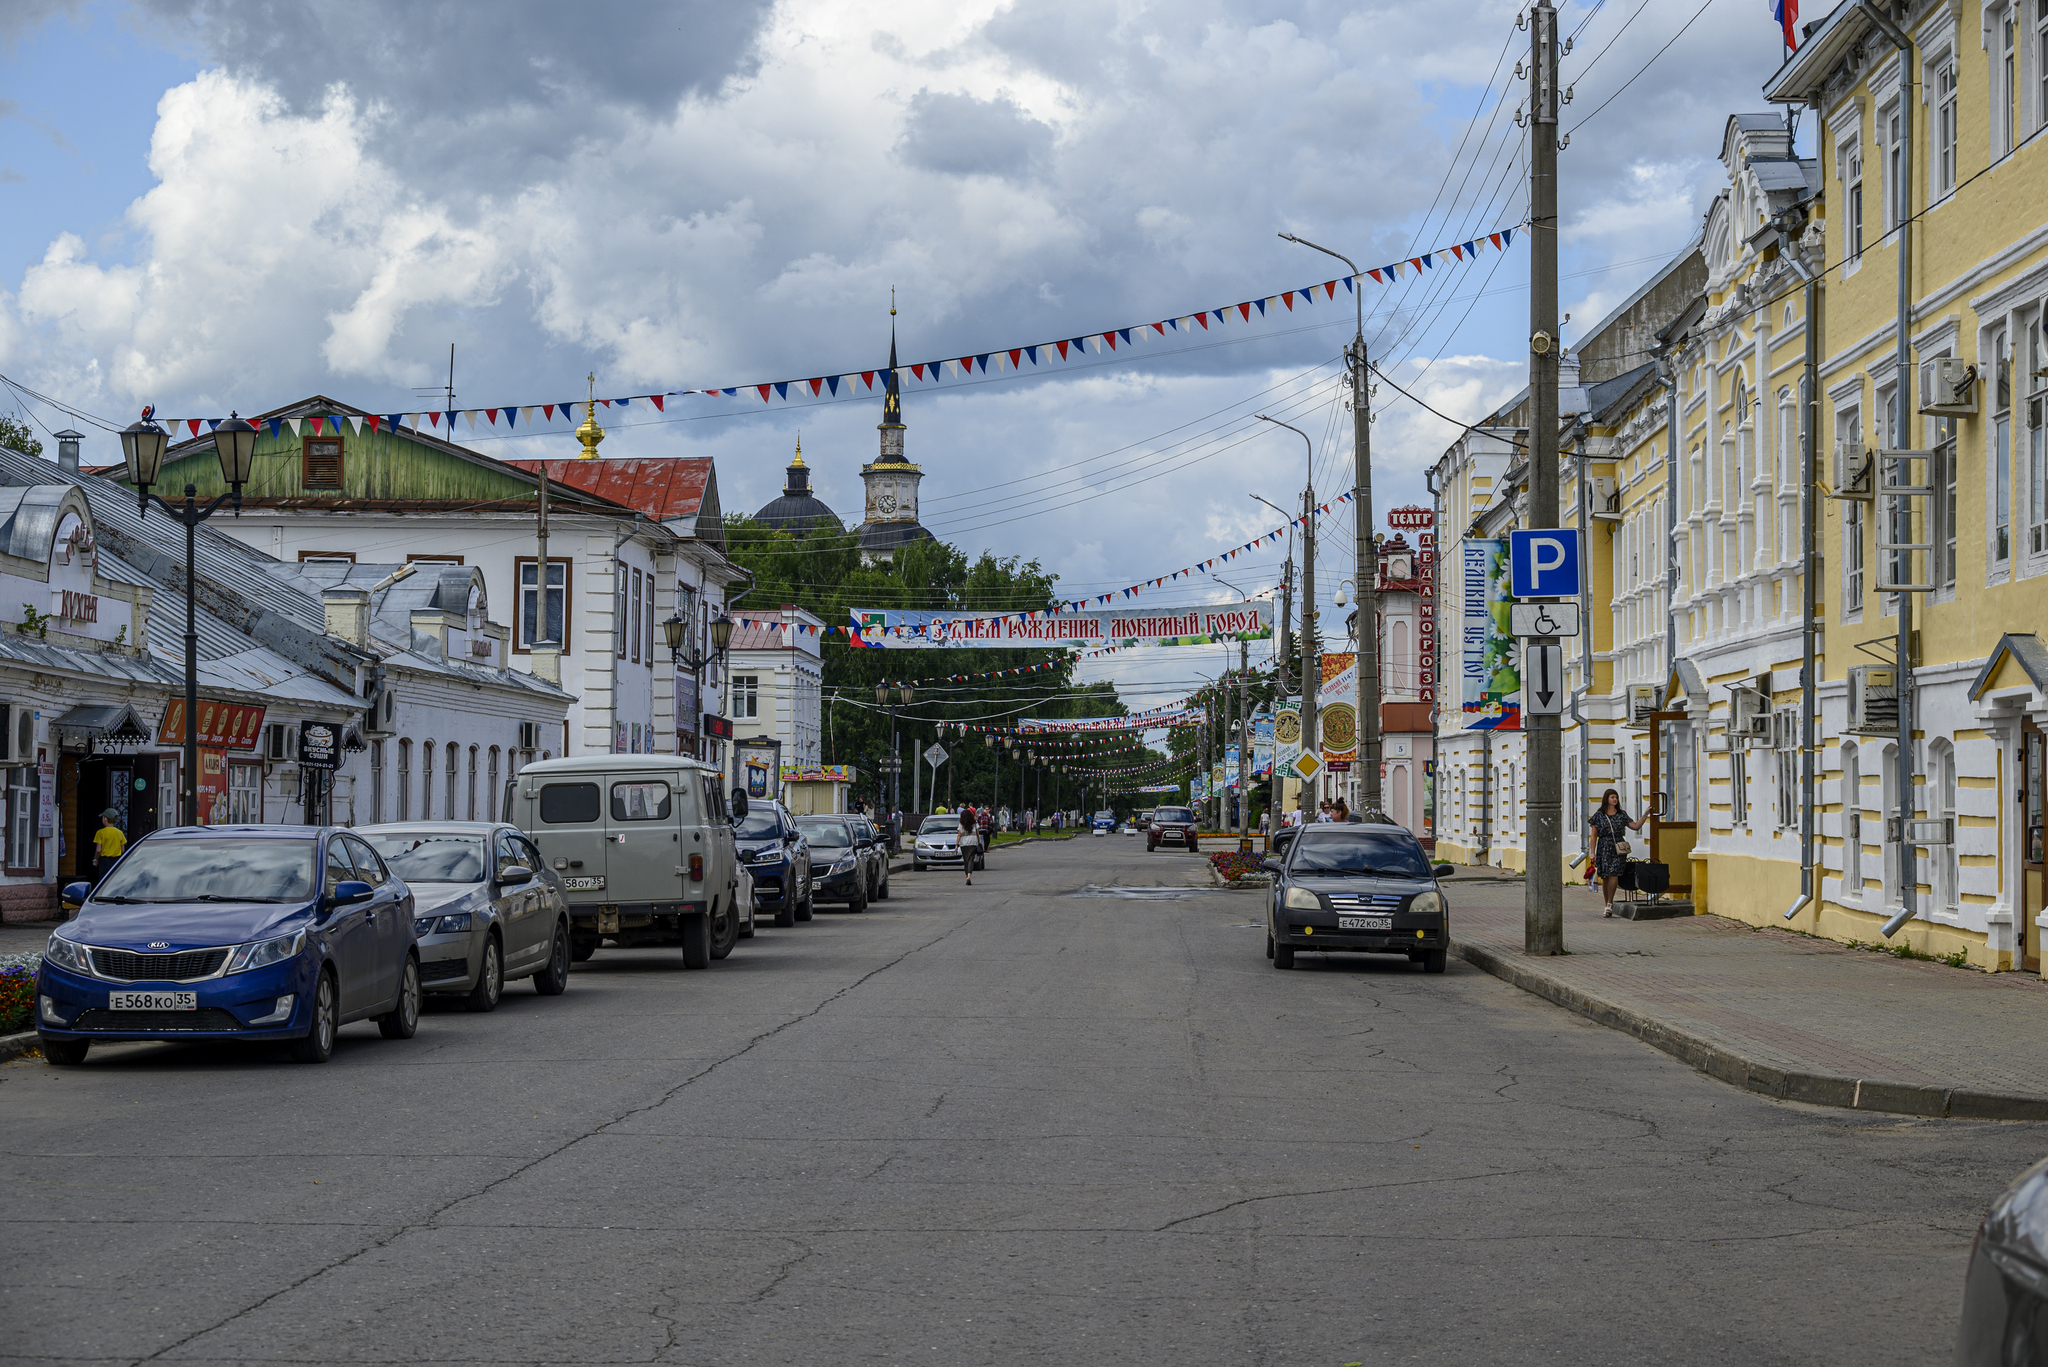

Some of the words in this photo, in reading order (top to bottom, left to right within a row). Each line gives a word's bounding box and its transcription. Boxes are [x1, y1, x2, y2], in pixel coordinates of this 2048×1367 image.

[1391, 513, 1432, 525] ТЕАТР
[1420, 534, 1433, 597] ДЕДА
[1530, 538, 1566, 590] P
[1464, 549, 1488, 618] ВЕЛИКИЙ
[61, 589, 98, 628] КУХНЯ
[1111, 612, 1200, 638] ЛЮБИМЫЙ
[1206, 610, 1261, 634] ГОРОД
[1420, 606, 1434, 701] МОРОЗА
[1464, 626, 1485, 684] УСТЮГ
[1341, 672, 1354, 682] 1147
[303, 745, 334, 754] ВКУСНЫЕ
[205, 756, 220, 772] АКЦИЯ
[1342, 919, 1378, 927] Е472КО
[115, 994, 173, 1008] Е568КО
[176, 994, 191, 1004] 35
